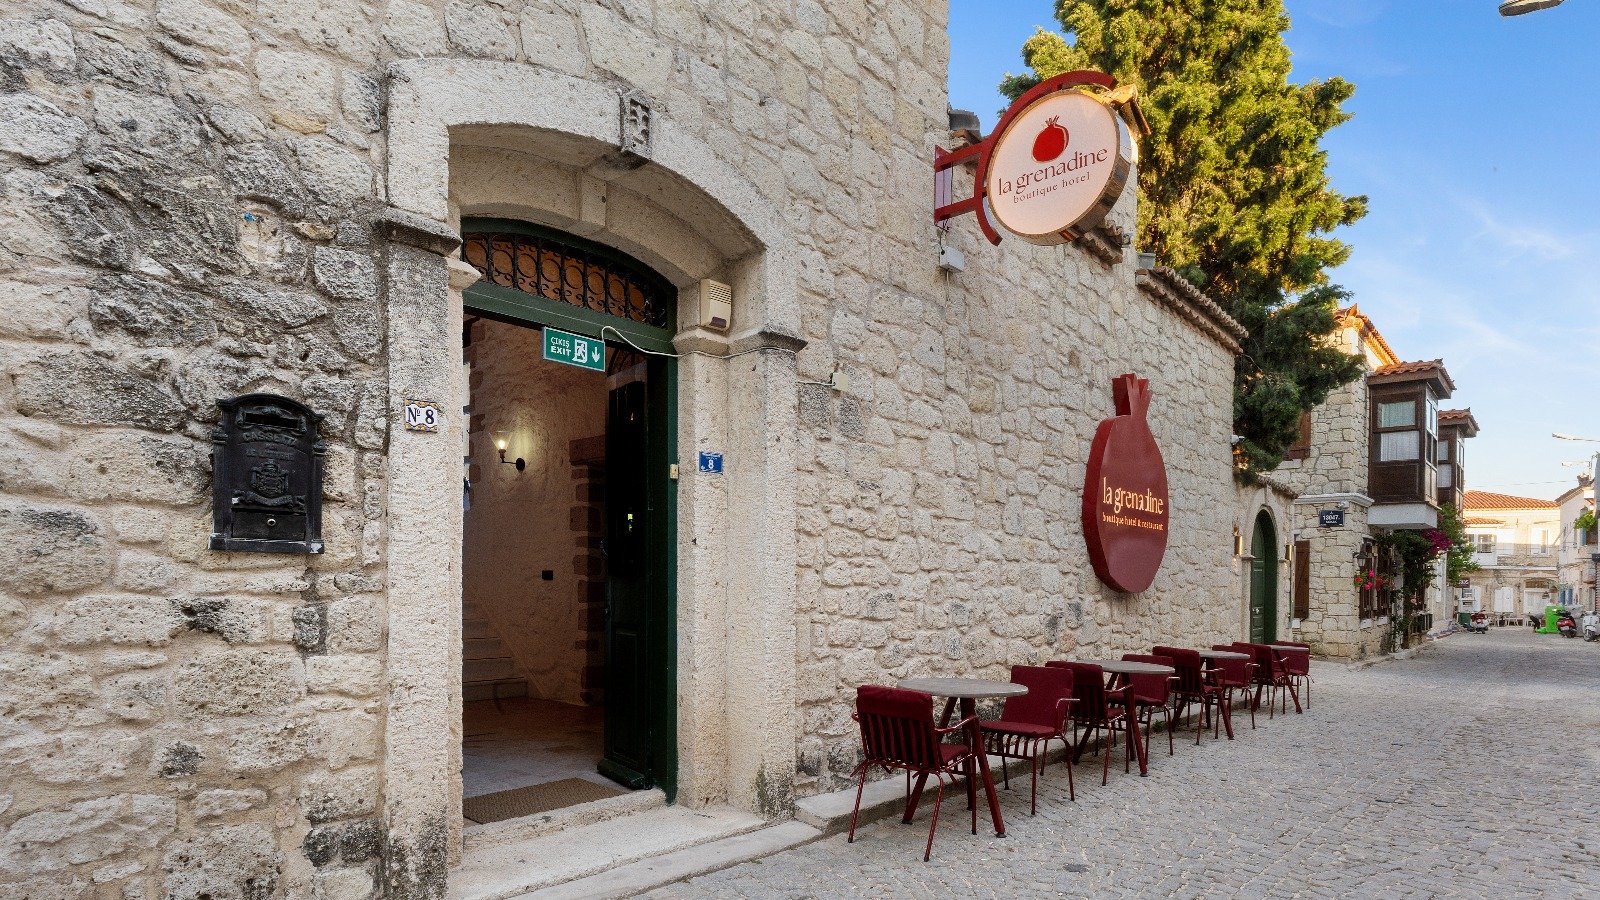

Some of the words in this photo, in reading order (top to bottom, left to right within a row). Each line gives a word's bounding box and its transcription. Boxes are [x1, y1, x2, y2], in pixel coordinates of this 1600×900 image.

[998, 178, 1012, 196] la
[1015, 148, 1108, 195] grenadine
[1013, 183, 1059, 204] boutique
[1061, 171, 1091, 188] hotel
[550, 336, 570, 349] ÇIKIŞ
[550, 345, 572, 357] EXIT
[425, 409, 435, 425] 8
[708, 459, 715, 470] 8
[1102, 476, 1113, 505] la
[1113, 487, 1164, 515] grenadine
[1102, 511, 1124, 527] boutique
[1124, 515, 1137, 527] hotel
